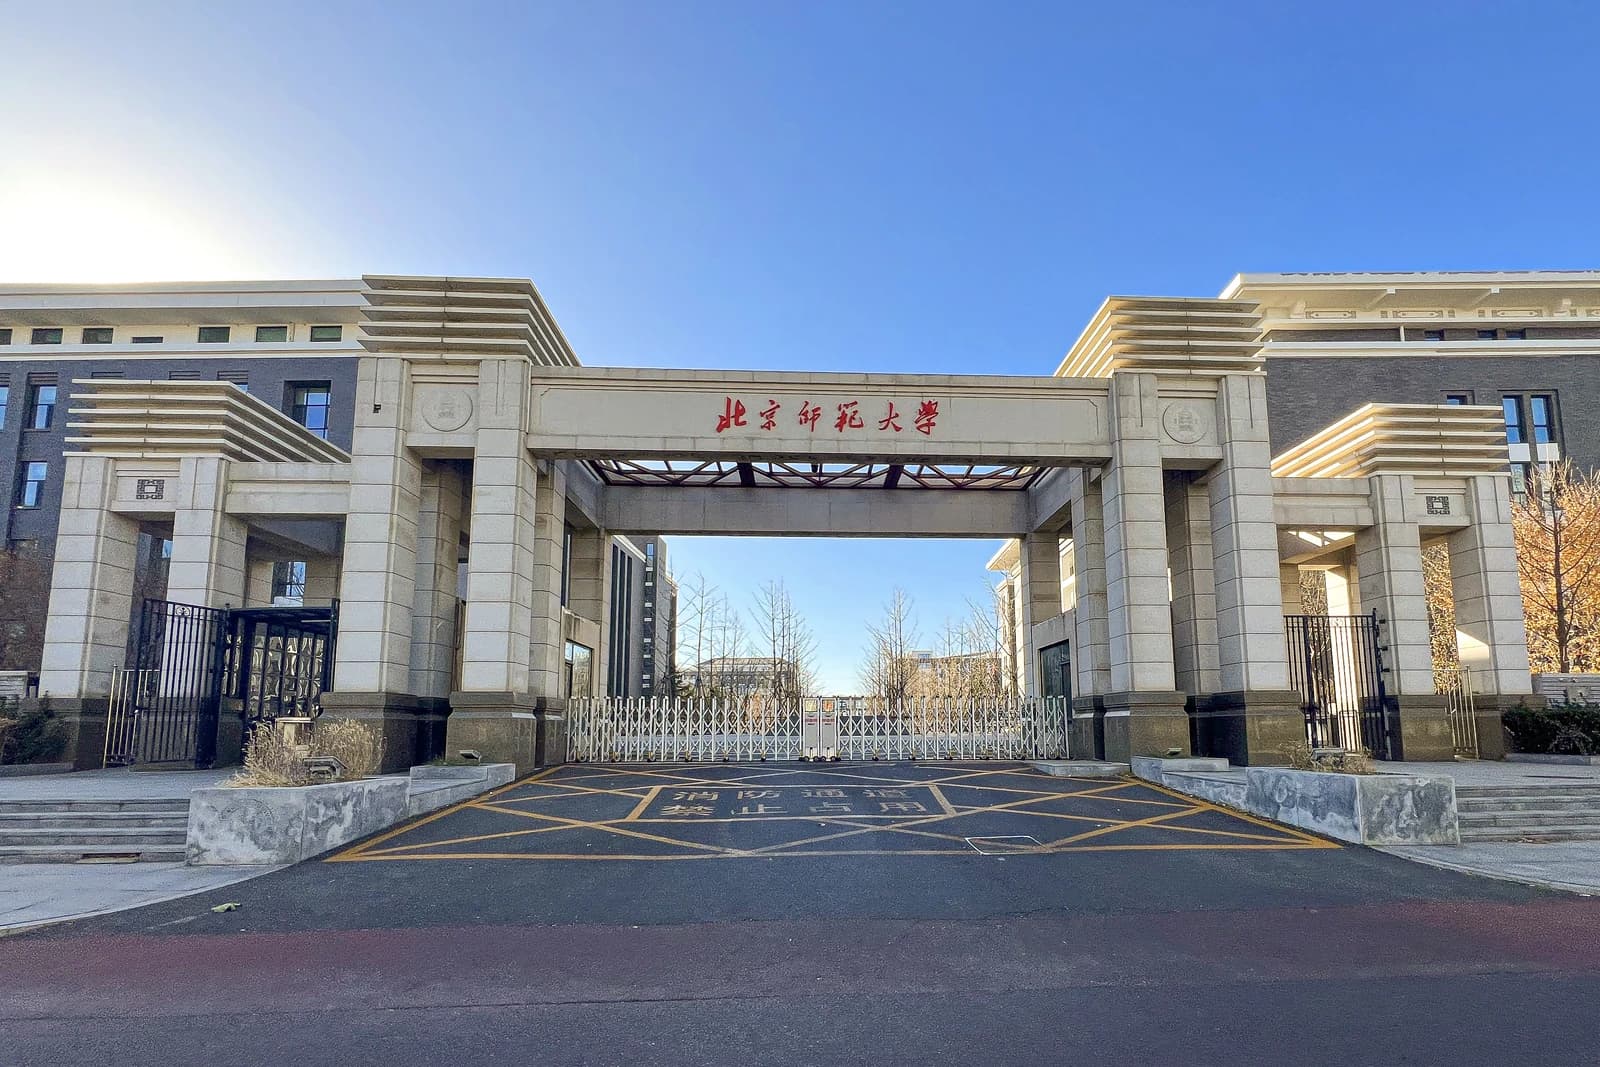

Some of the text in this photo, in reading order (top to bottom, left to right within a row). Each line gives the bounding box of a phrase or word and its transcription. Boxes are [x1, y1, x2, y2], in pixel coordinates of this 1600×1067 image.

[672, 789, 912, 801] 消防通道
[660, 801, 927, 816] 禁止占用
